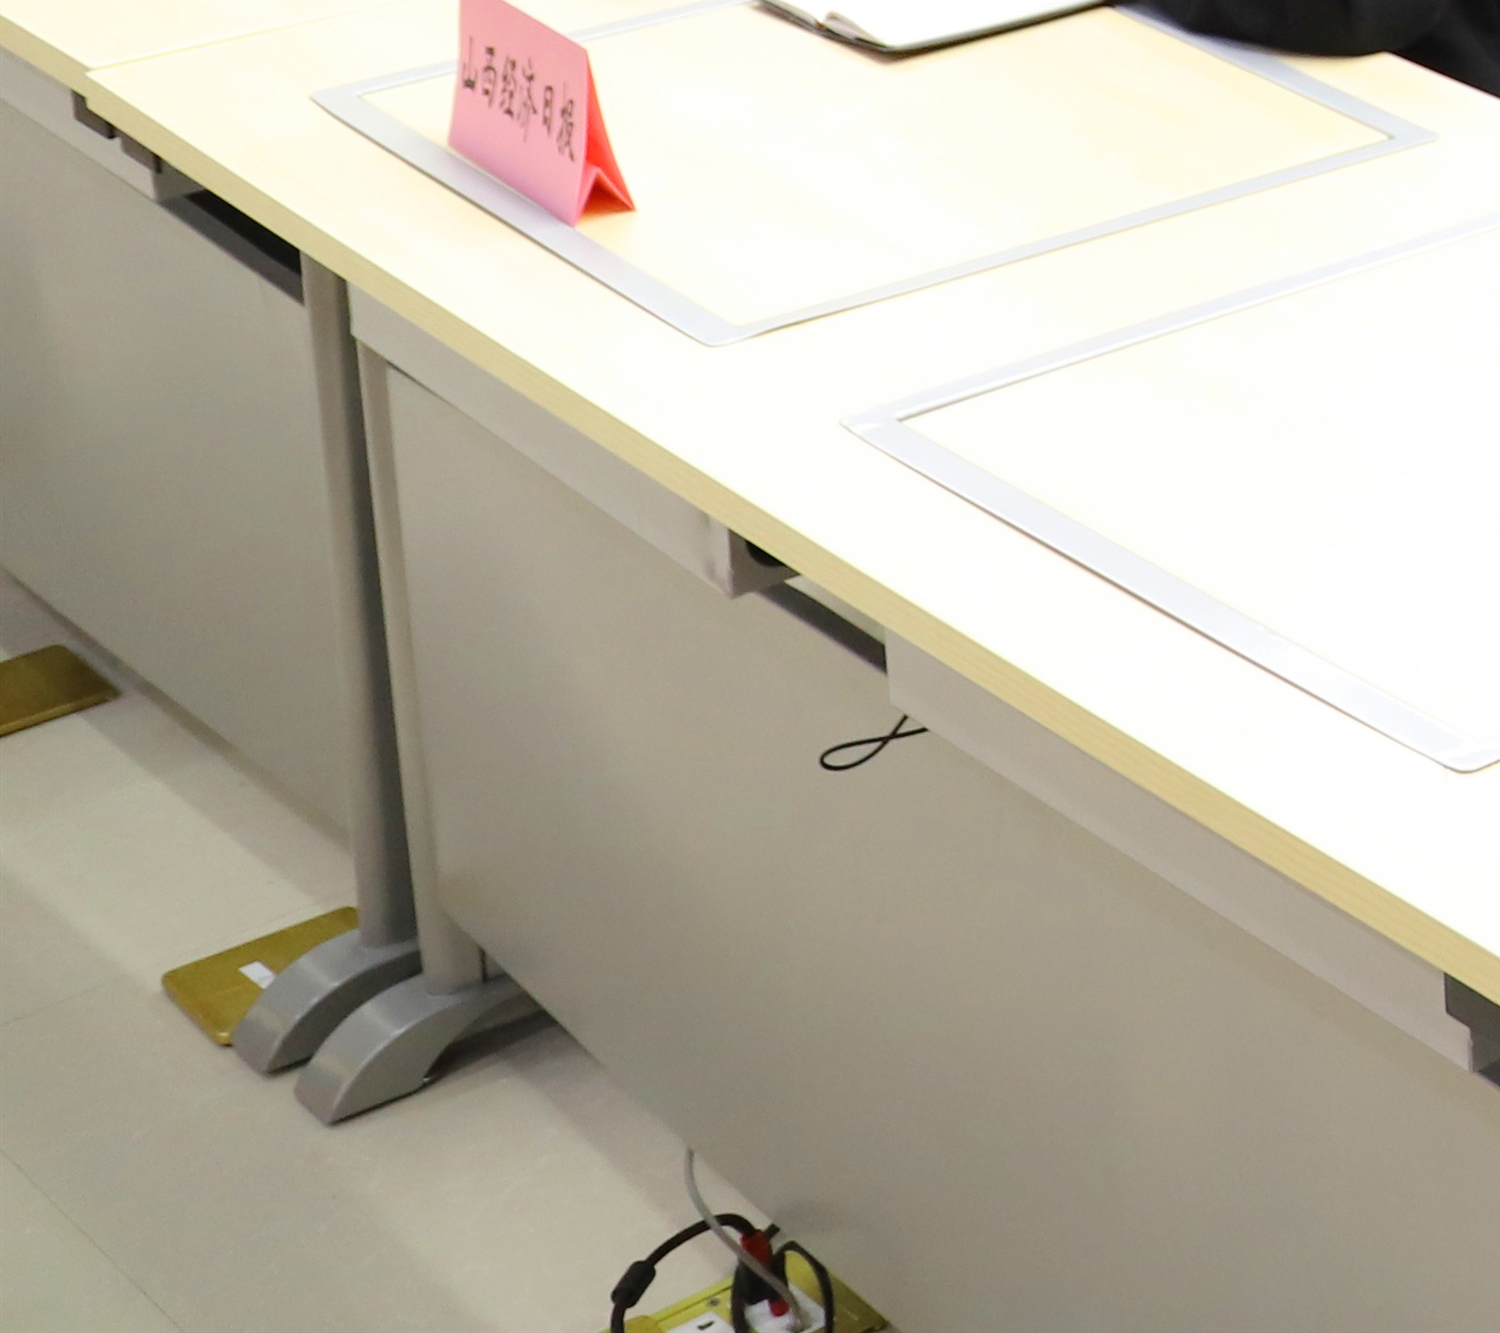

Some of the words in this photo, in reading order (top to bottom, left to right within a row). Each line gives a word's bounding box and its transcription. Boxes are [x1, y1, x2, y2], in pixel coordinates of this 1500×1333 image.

[463, 35, 575, 162] 山西经济日报
